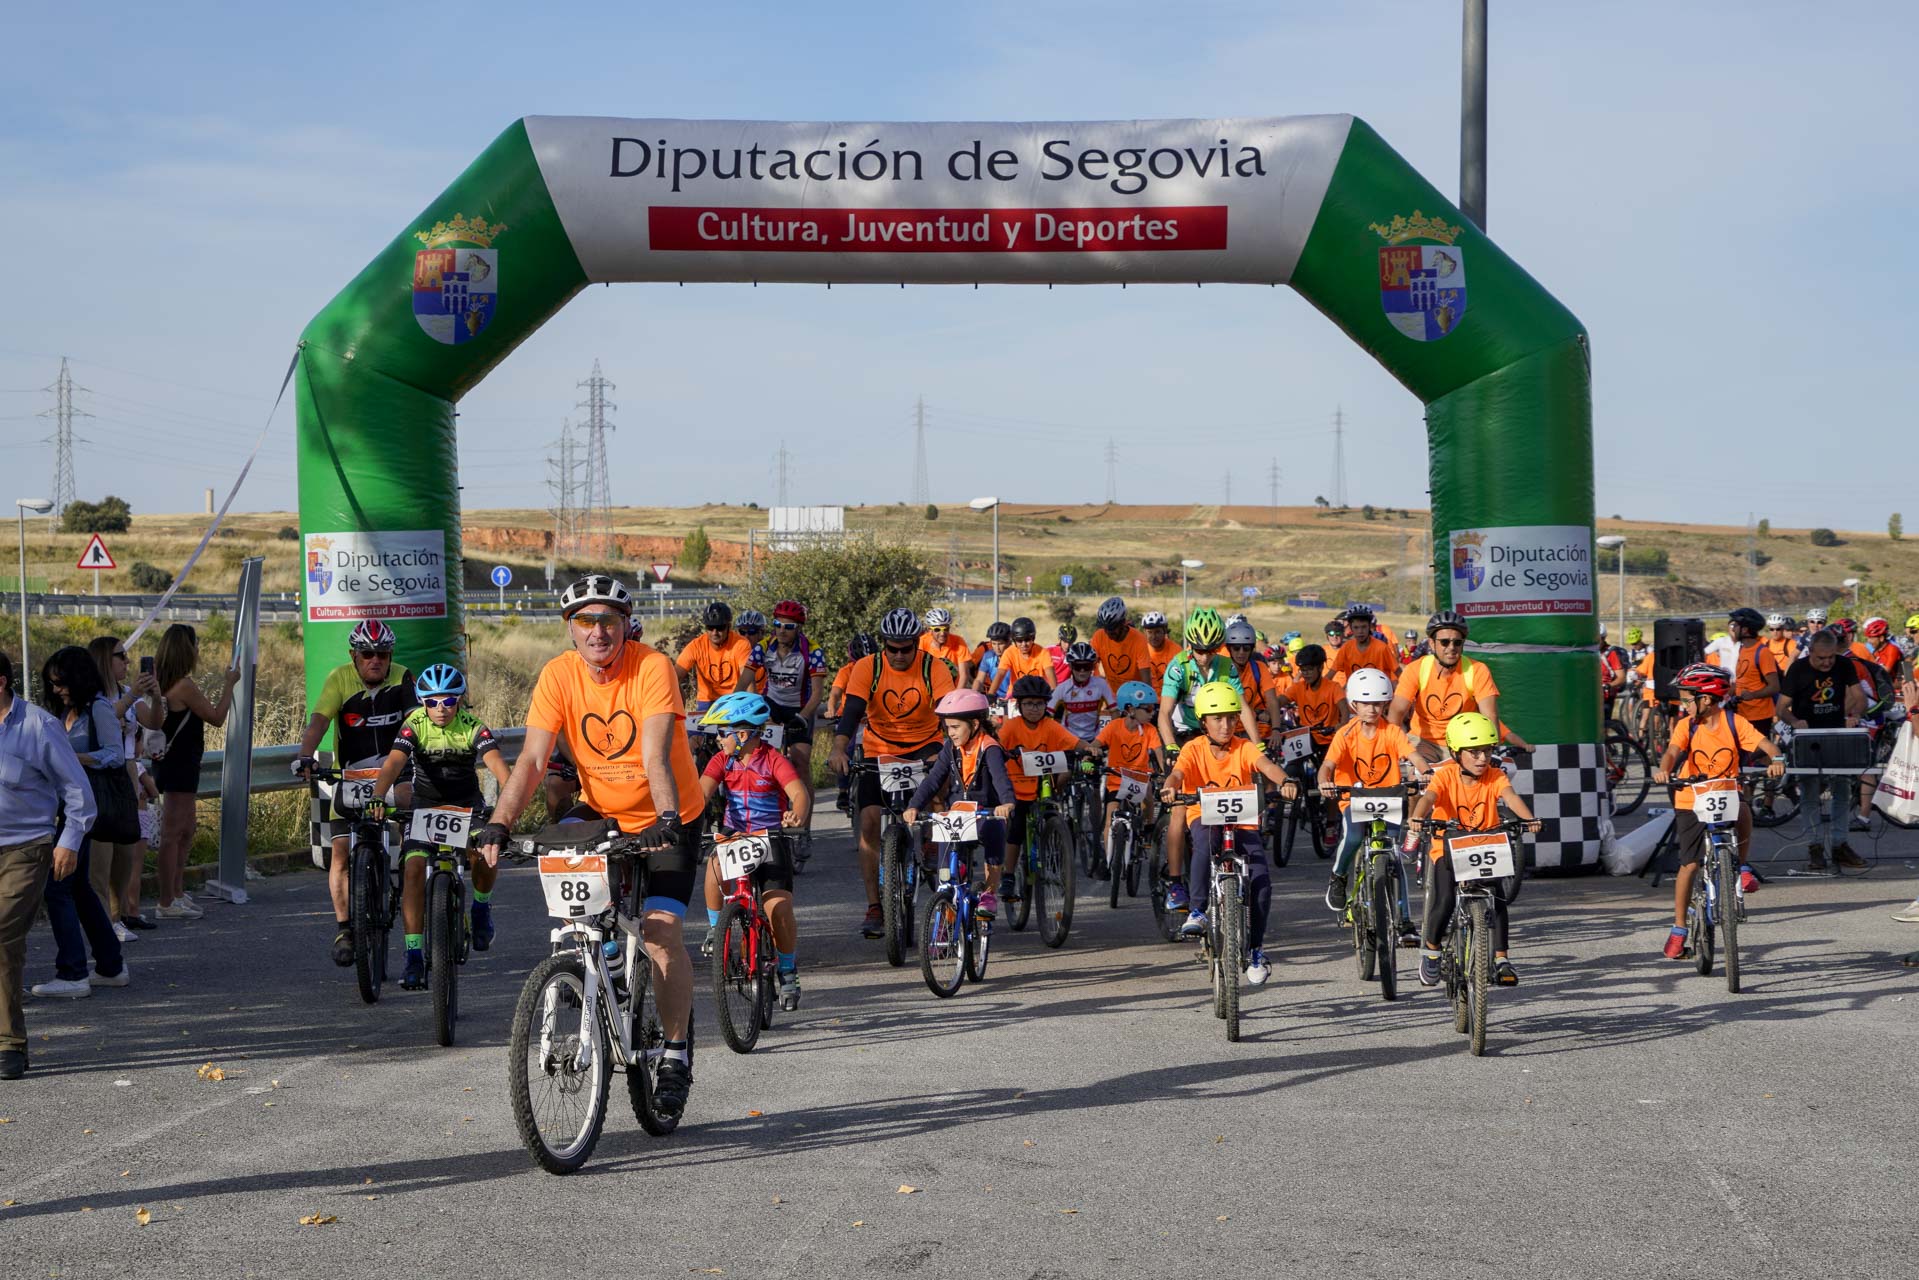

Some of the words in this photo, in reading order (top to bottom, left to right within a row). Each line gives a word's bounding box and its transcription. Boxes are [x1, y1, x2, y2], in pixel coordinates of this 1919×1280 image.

[610, 137, 924, 192] Diputación
[948, 140, 1019, 181] de
[1042, 139, 1267, 194] Segovia
[697, 212, 829, 246] Cultura,
[841, 213, 990, 243] Juventud
[1003, 219, 1021, 248] y
[1034, 213, 1179, 248] Deportes
[337, 548, 439, 572] Diputación
[1490, 543, 1587, 567] Diputación
[337, 575, 361, 592] de
[367, 573, 440, 596] Segovia
[1490, 570, 1516, 588] de
[1523, 568, 1588, 591] Segovia
[316, 607, 345, 617] Cultura,
[346, 606, 388, 616] Juventud
[391, 606, 397, 615] y
[399, 604, 437, 615] Deportes
[1464, 603, 1499, 613] Cultura,
[1501, 602, 1543, 611] Juventud
[1546, 602, 1551, 610] y
[1288, 739, 1303, 752] 16
[1034, 753, 1056, 768] 30
[1127, 783, 1141, 794] 49
[1217, 798, 1244, 814] 55
[1364, 802, 1389, 813] 92
[1705, 797, 1728, 812] 35
[422, 813, 462, 833] 166
[943, 816, 964, 830] 34
[727, 842, 765, 864] 165
[1468, 851, 1497, 867] 95
[560, 880, 591, 901] 88
